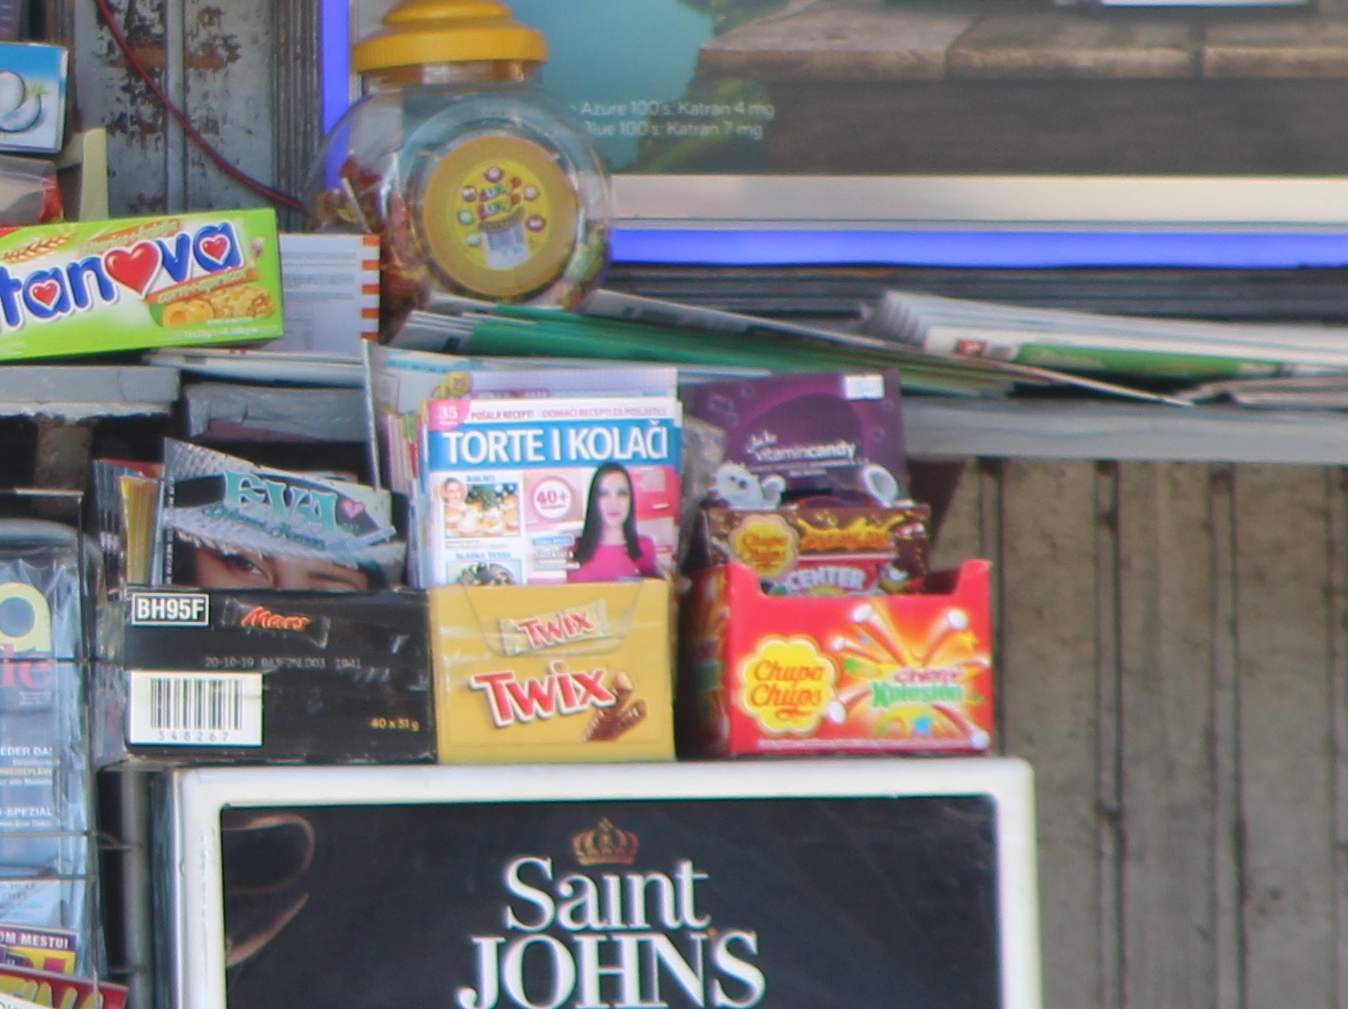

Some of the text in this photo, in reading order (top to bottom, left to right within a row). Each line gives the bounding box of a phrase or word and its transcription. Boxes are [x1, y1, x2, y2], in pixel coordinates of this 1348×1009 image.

[442, 419, 669, 465] TORTE I KOLAČI
[755, 441, 856, 468] vitamincandy
[787, 567, 865, 590] CENTER
[136, 598, 205, 620] BH95F
[753, 659, 825, 684] Chupa
[468, 659, 616, 727] Twix
[749, 681, 824, 711] Chups
[505, 856, 712, 933] Saint
